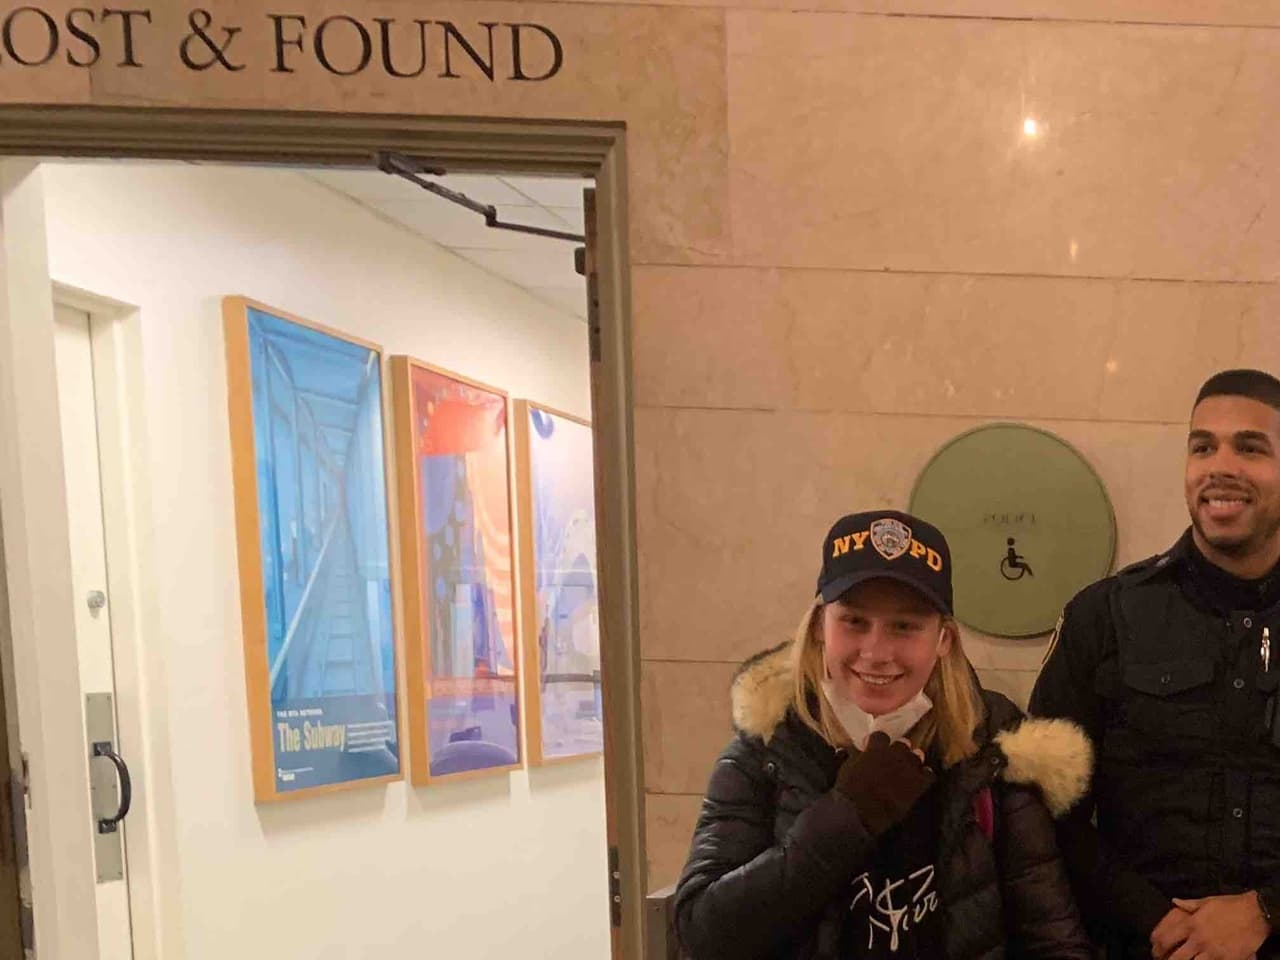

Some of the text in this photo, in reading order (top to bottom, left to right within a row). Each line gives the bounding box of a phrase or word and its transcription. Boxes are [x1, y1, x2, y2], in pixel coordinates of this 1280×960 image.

[0, 6, 564, 82] OST & FOUND
[278, 722, 301, 752] The
[303, 720, 345, 752] Subway
